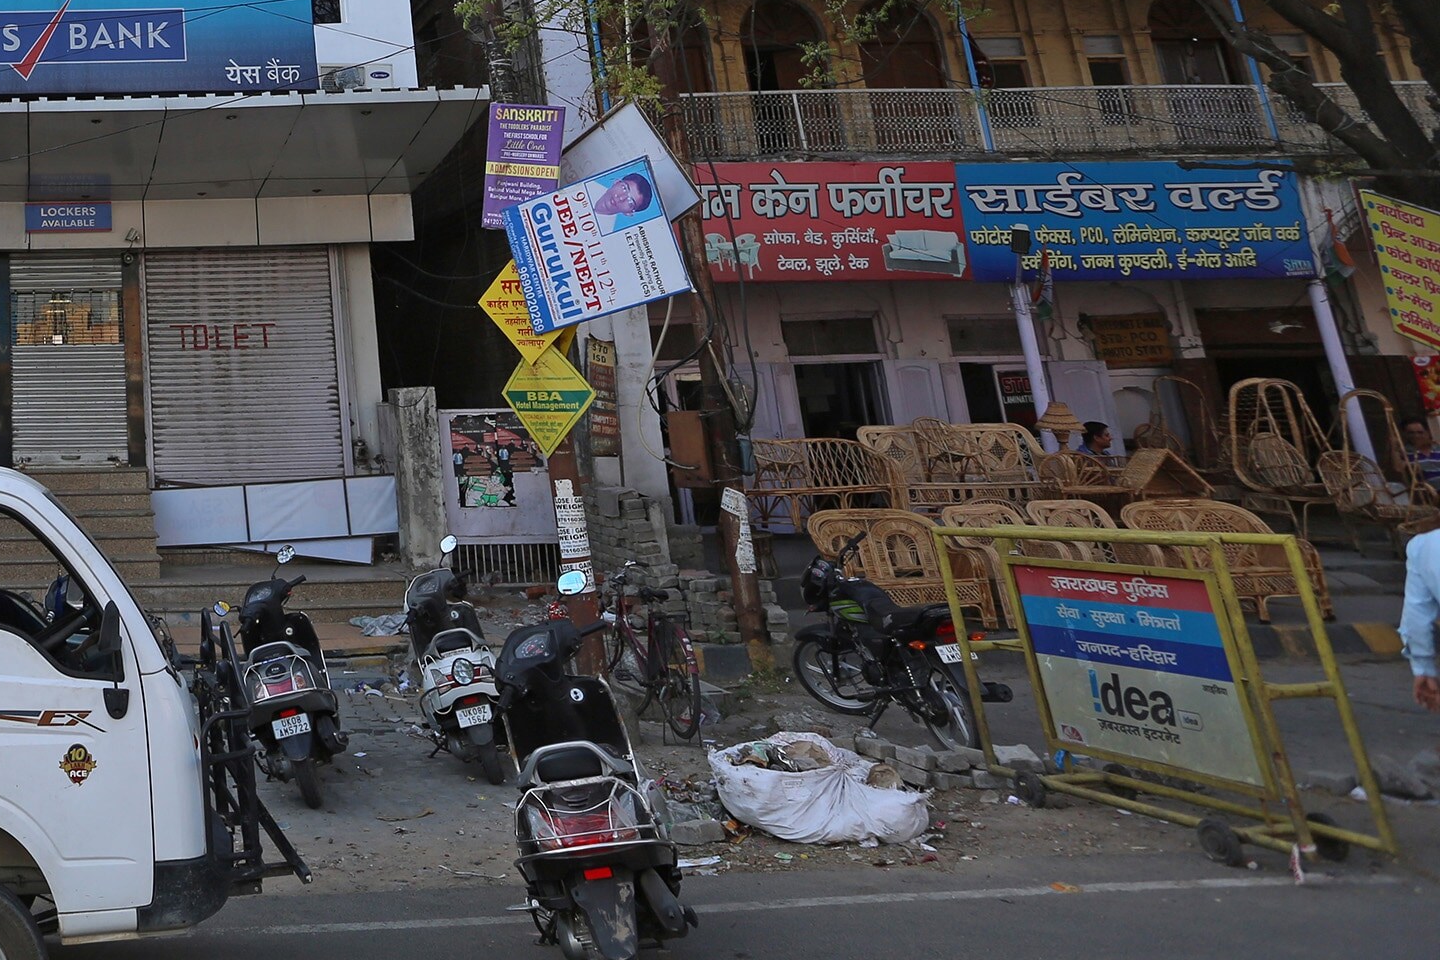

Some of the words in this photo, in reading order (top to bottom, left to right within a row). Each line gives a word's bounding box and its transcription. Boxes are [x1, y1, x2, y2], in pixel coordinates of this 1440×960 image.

[69, 21, 171, 50] BANK
[225, 60, 260, 85] येस
[266, 58, 301, 84] बैंक
[505, 140, 526, 150] Little
[527, 141, 545, 151] Ones
[490, 164, 534, 176] ADMISSIONS
[535, 167, 555, 177] OPEN
[749, 168, 820, 220] केन
[826, 167, 955, 219] फर्नीचर
[965, 171, 1157, 218] साईबर
[1163, 169, 1285, 211] वर्ल्ड
[41, 207, 96, 216] LOCKERS
[41, 219, 95, 227] AVAILABLE
[763, 230, 801, 246] सोफा,
[1080, 227, 1109, 244] PCO,
[1274, 221, 1300, 241] वर्क
[519, 235, 536, 273] HARIDWAR
[531, 272, 543, 298] CENTRE
[531, 201, 584, 318] Gurukul
[630, 249, 645, 281] Lucknow
[637, 224, 654, 260] ABHISHEK
[649, 260, 666, 295] RATHOUR
[777, 255, 811, 271] टेबल,
[848, 255, 869, 271] रैक
[1080, 254, 1115, 269] जन्म
[1176, 247, 1222, 271] ई-मेल
[1224, 246, 1258, 269] आदि
[519, 266, 545, 332] 9690020269
[516, 401, 531, 409] Hotel
[532, 402, 579, 411] Management
[527, 392, 562, 400] BBA
[1048, 576, 1119, 595] उत्तराखण्ड
[1121, 577, 1169, 602] पुलिस
[1056, 603, 1080, 619] सेवा
[1089, 610, 1126, 628] सुरक्षा
[70, 748, 85, 761] 10
